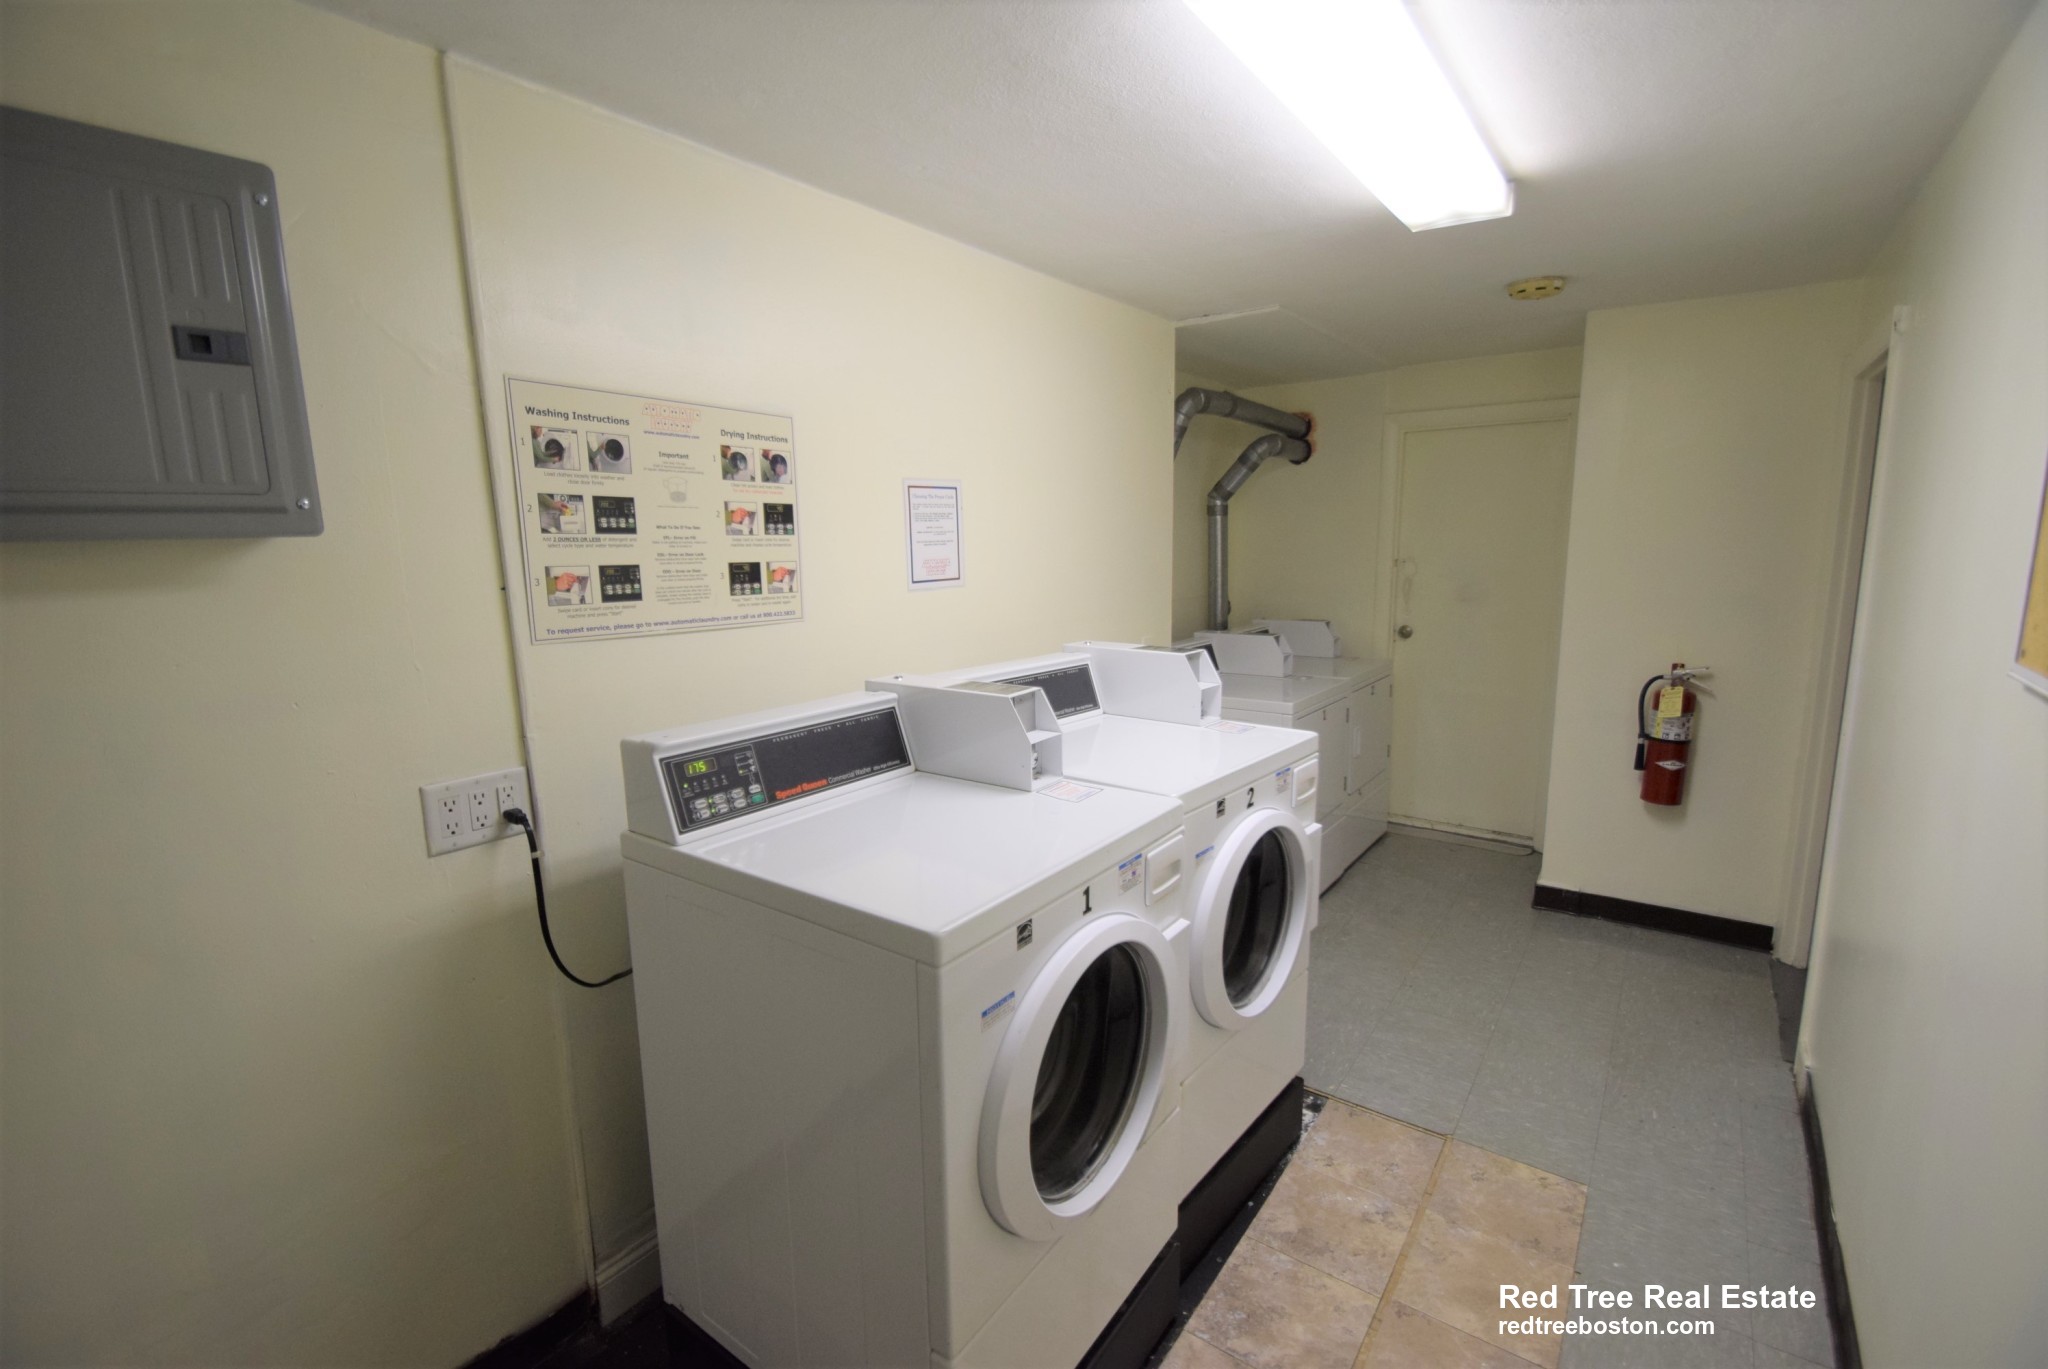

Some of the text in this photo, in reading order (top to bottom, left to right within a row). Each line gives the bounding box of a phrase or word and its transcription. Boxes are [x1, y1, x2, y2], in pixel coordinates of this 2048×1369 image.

[525, 405, 630, 426] Washing Instructions
[520, 437, 525, 446] 1
[720, 429, 788, 443] Drying Instructions
[658, 451, 689, 460] Important
[527, 504, 533, 513] 2
[534, 578, 540, 587] 3
[557, 627, 584, 635] request
[586, 624, 611, 632] service,
[613, 623, 634, 631] please
[688, 760, 706, 774] 175
[828, 771, 855, 784] Commercial
[855, 766, 872, 776] Washer
[1246, 787, 1255, 809] 2
[1082, 885, 1092, 916] 1
